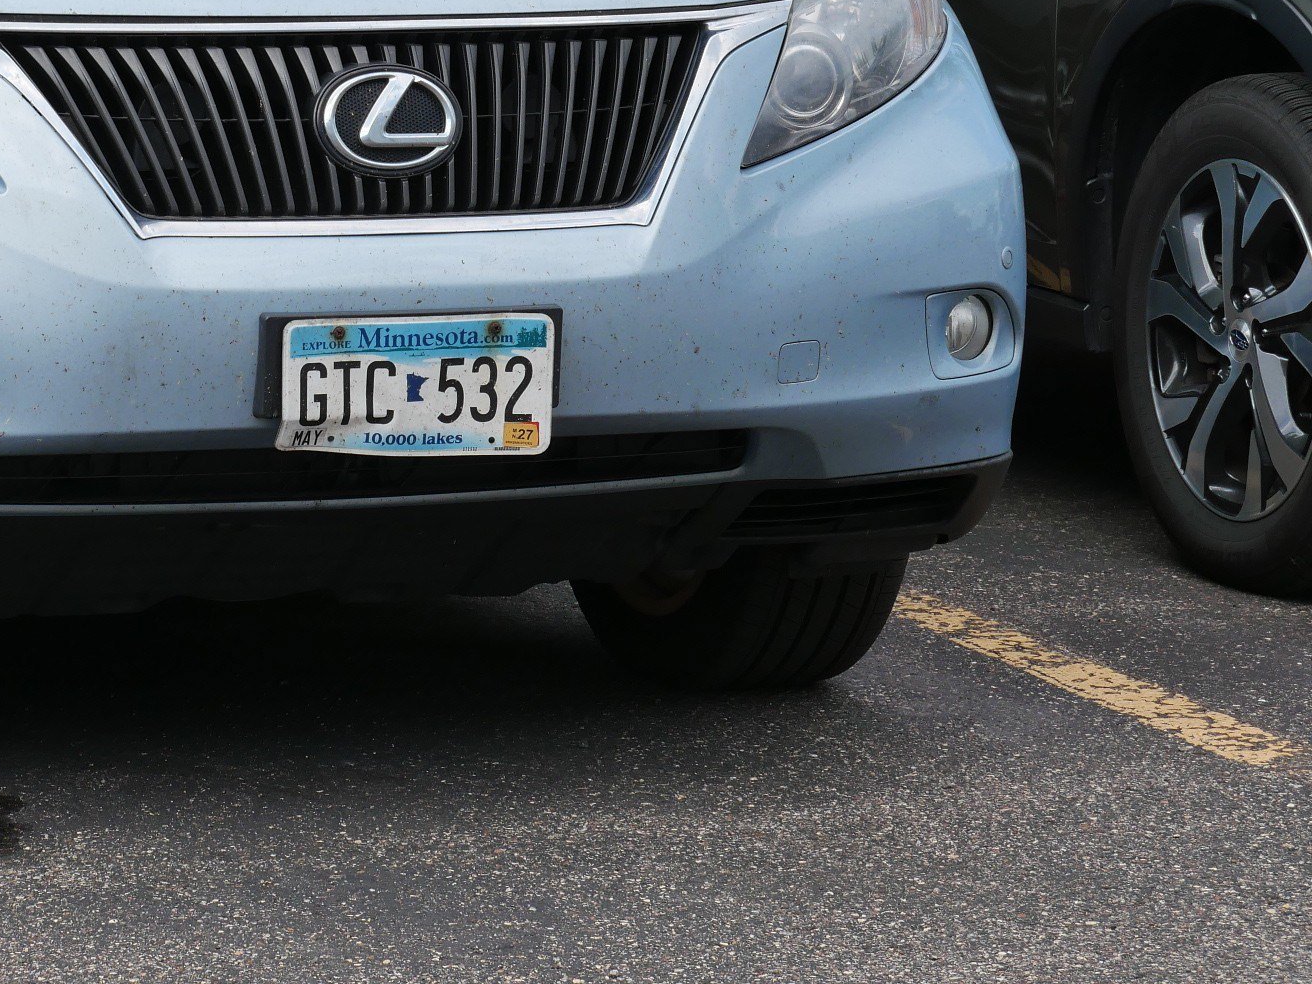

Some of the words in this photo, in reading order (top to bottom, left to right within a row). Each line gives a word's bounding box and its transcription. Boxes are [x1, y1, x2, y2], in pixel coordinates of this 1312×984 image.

[302, 340, 352, 351] EXPLORE
[357, 327, 514, 349] Minnesota.com
[298, 360, 397, 427] GTC
[437, 356, 534, 424] 532
[291, 429, 324, 447] MAY
[362, 432, 417, 446] 10,000
[421, 432, 463, 445] lakes
[517, 428, 534, 441] 27
